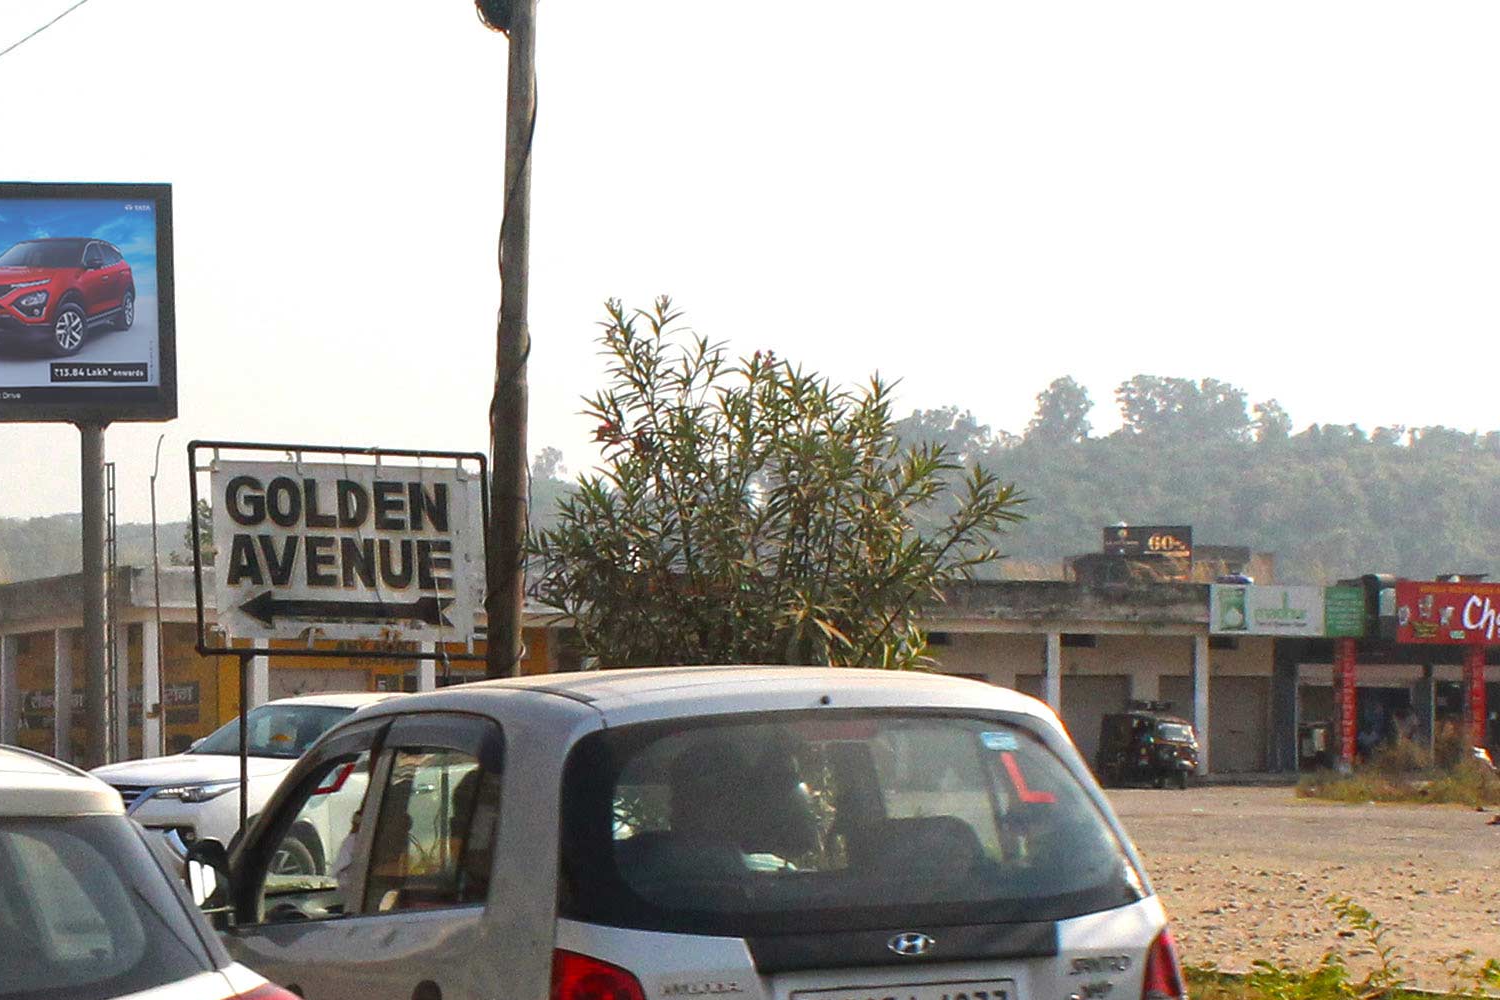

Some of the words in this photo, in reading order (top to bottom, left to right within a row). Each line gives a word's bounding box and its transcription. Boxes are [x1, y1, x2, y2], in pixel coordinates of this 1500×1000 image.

[113, 368, 145, 377] onwards
[2, 391, 22, 400] Drive
[225, 475, 450, 532] GOLDEN
[226, 533, 454, 590] AVENUE
